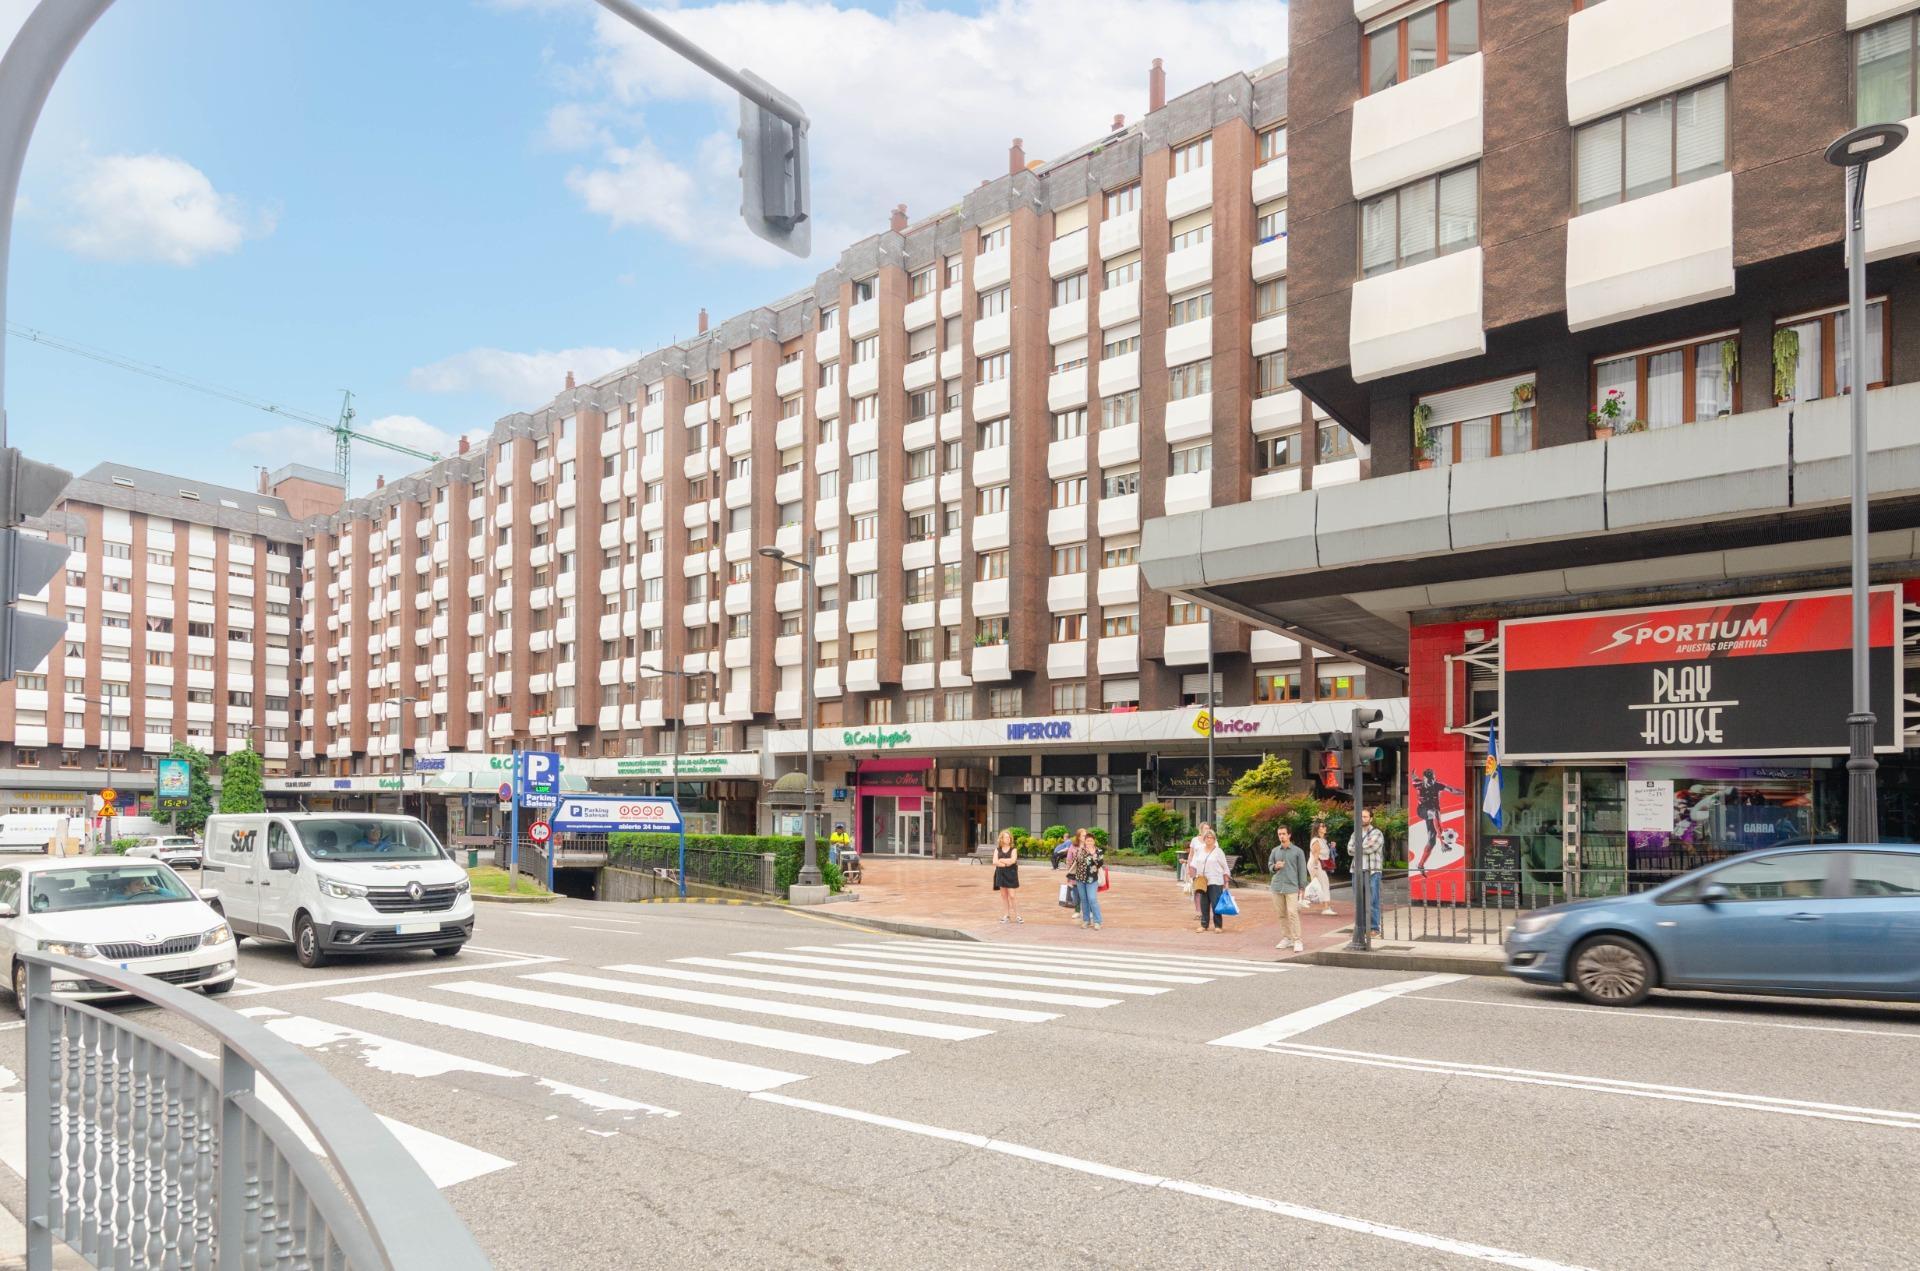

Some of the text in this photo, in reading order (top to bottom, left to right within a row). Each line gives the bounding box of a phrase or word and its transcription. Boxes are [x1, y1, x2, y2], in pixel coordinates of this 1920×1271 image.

[1590, 618, 1768, 655] SPORTIUM
[1675, 638, 1768, 653] APUESTAS DEPORTIVAS
[1653, 665, 1712, 704] PLAY
[1007, 721, 1071, 740] HIPERCOR
[1214, 719, 1260, 733] BriCor
[1640, 707, 1724, 744] HOUSE
[843, 731, 853, 745] El
[528, 755, 549, 780] P
[1023, 777, 1112, 793] HIPERCOR
[526, 794, 557, 803] Parking
